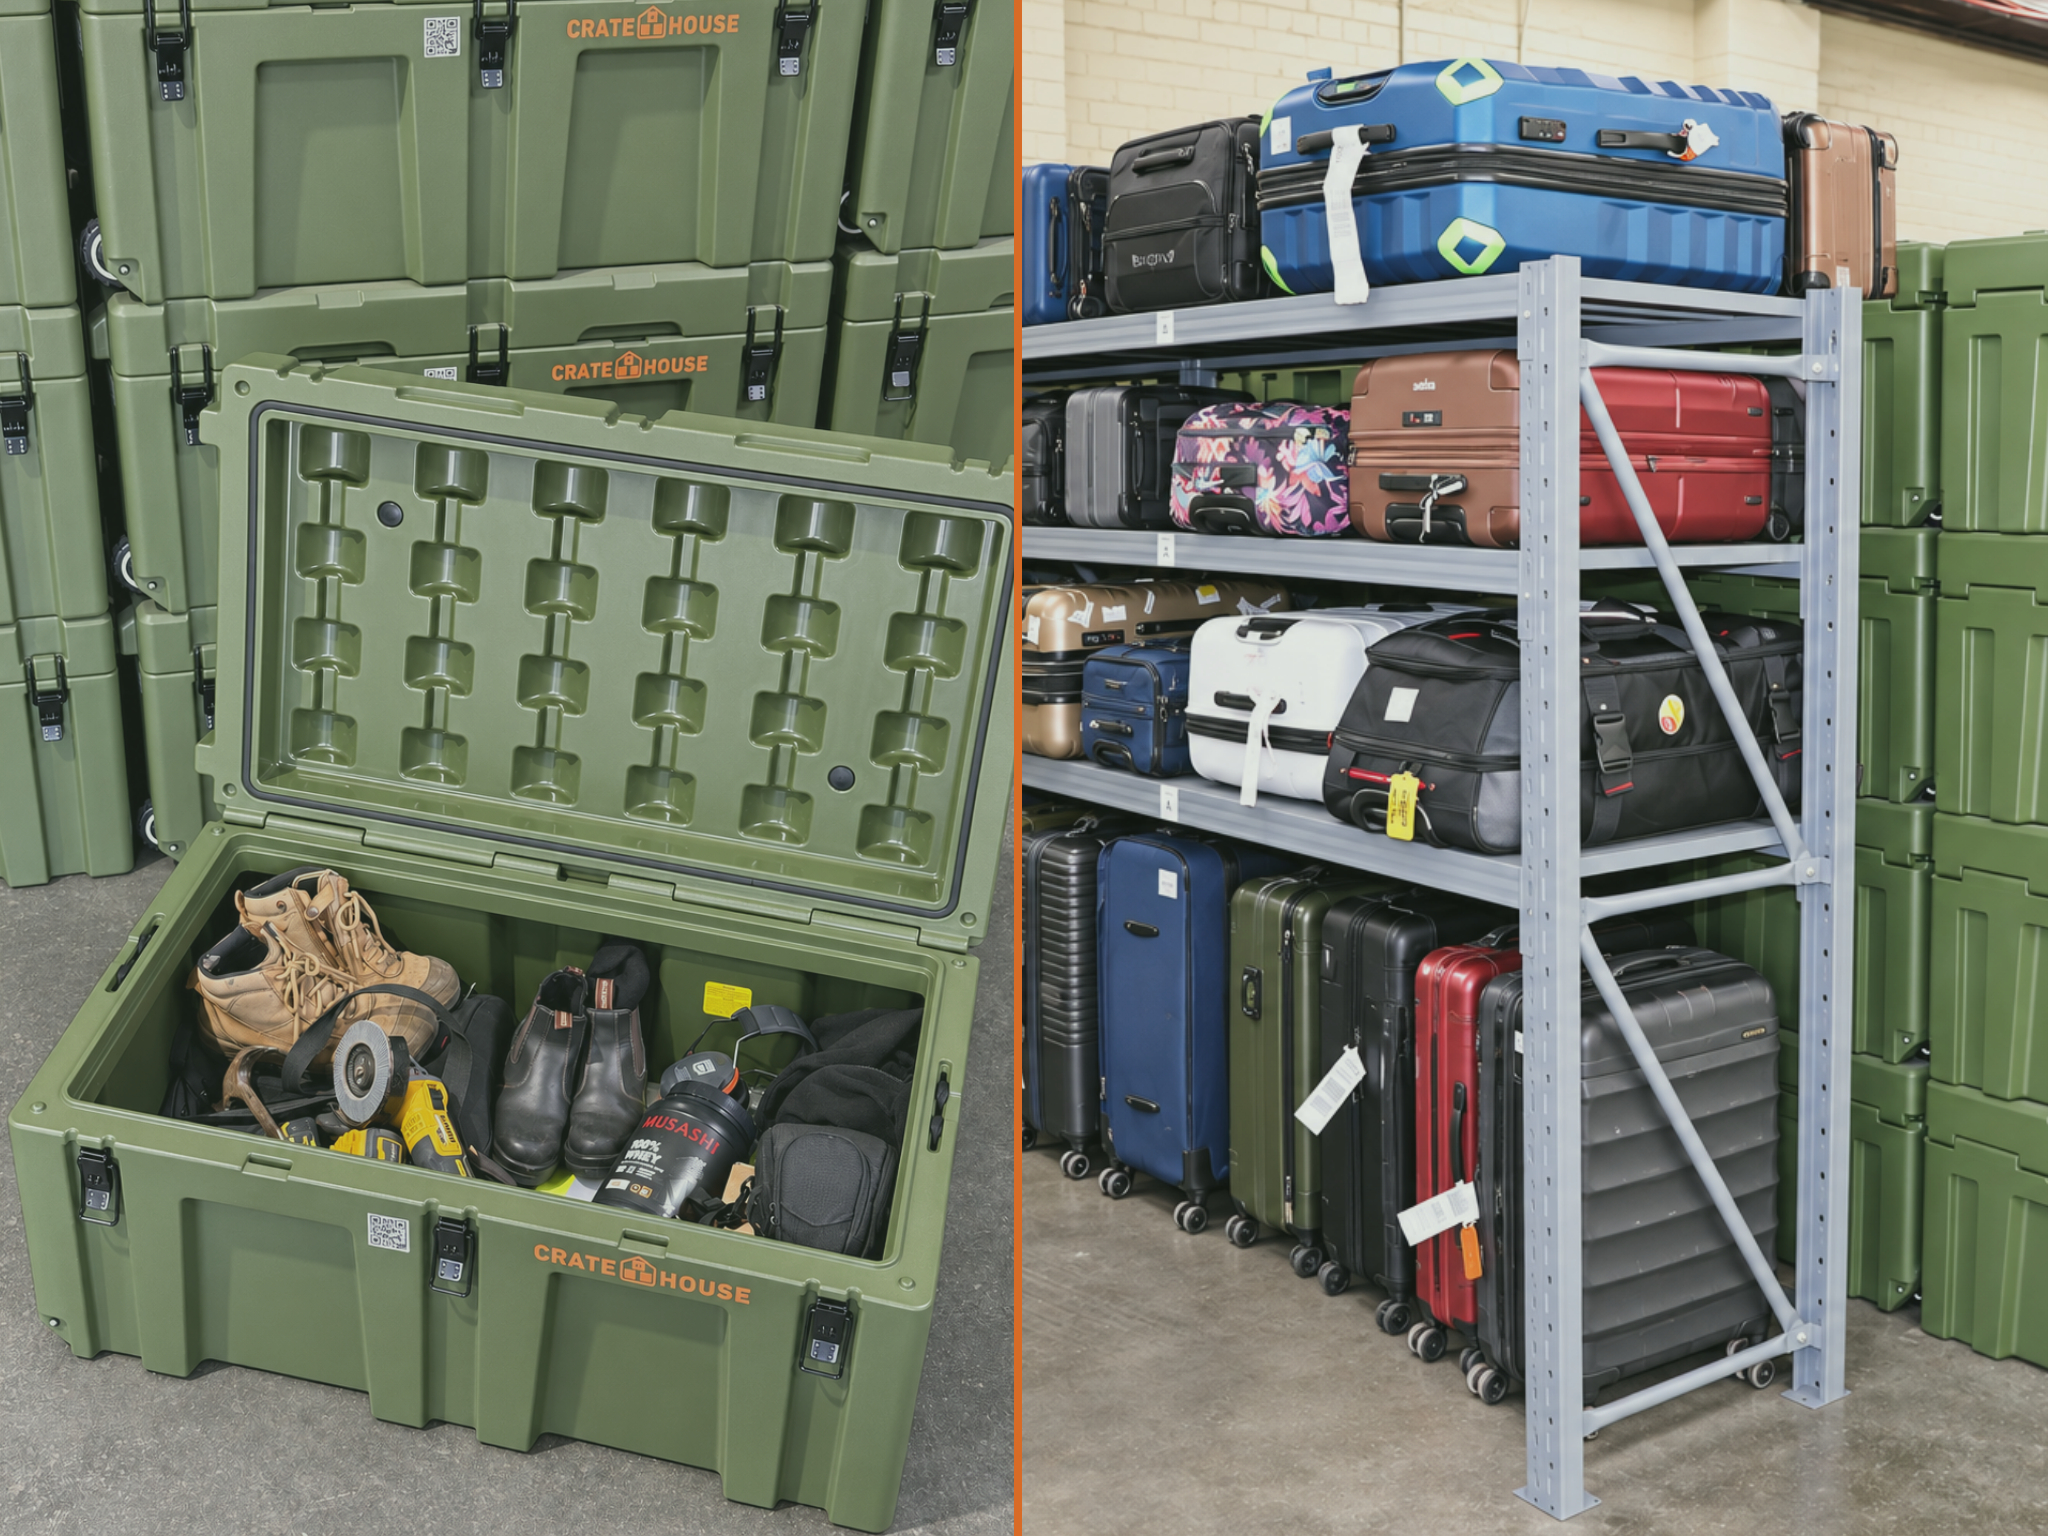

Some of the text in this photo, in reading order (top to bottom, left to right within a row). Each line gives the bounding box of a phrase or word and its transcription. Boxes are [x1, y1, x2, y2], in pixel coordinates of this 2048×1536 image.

[567, 14, 739, 38] CRATE HOUSE
[552, 355, 708, 381] CRATE HOUSE
[642, 1115, 720, 1155] MUSASHI
[534, 1244, 751, 1304] CRATE HOUSE
